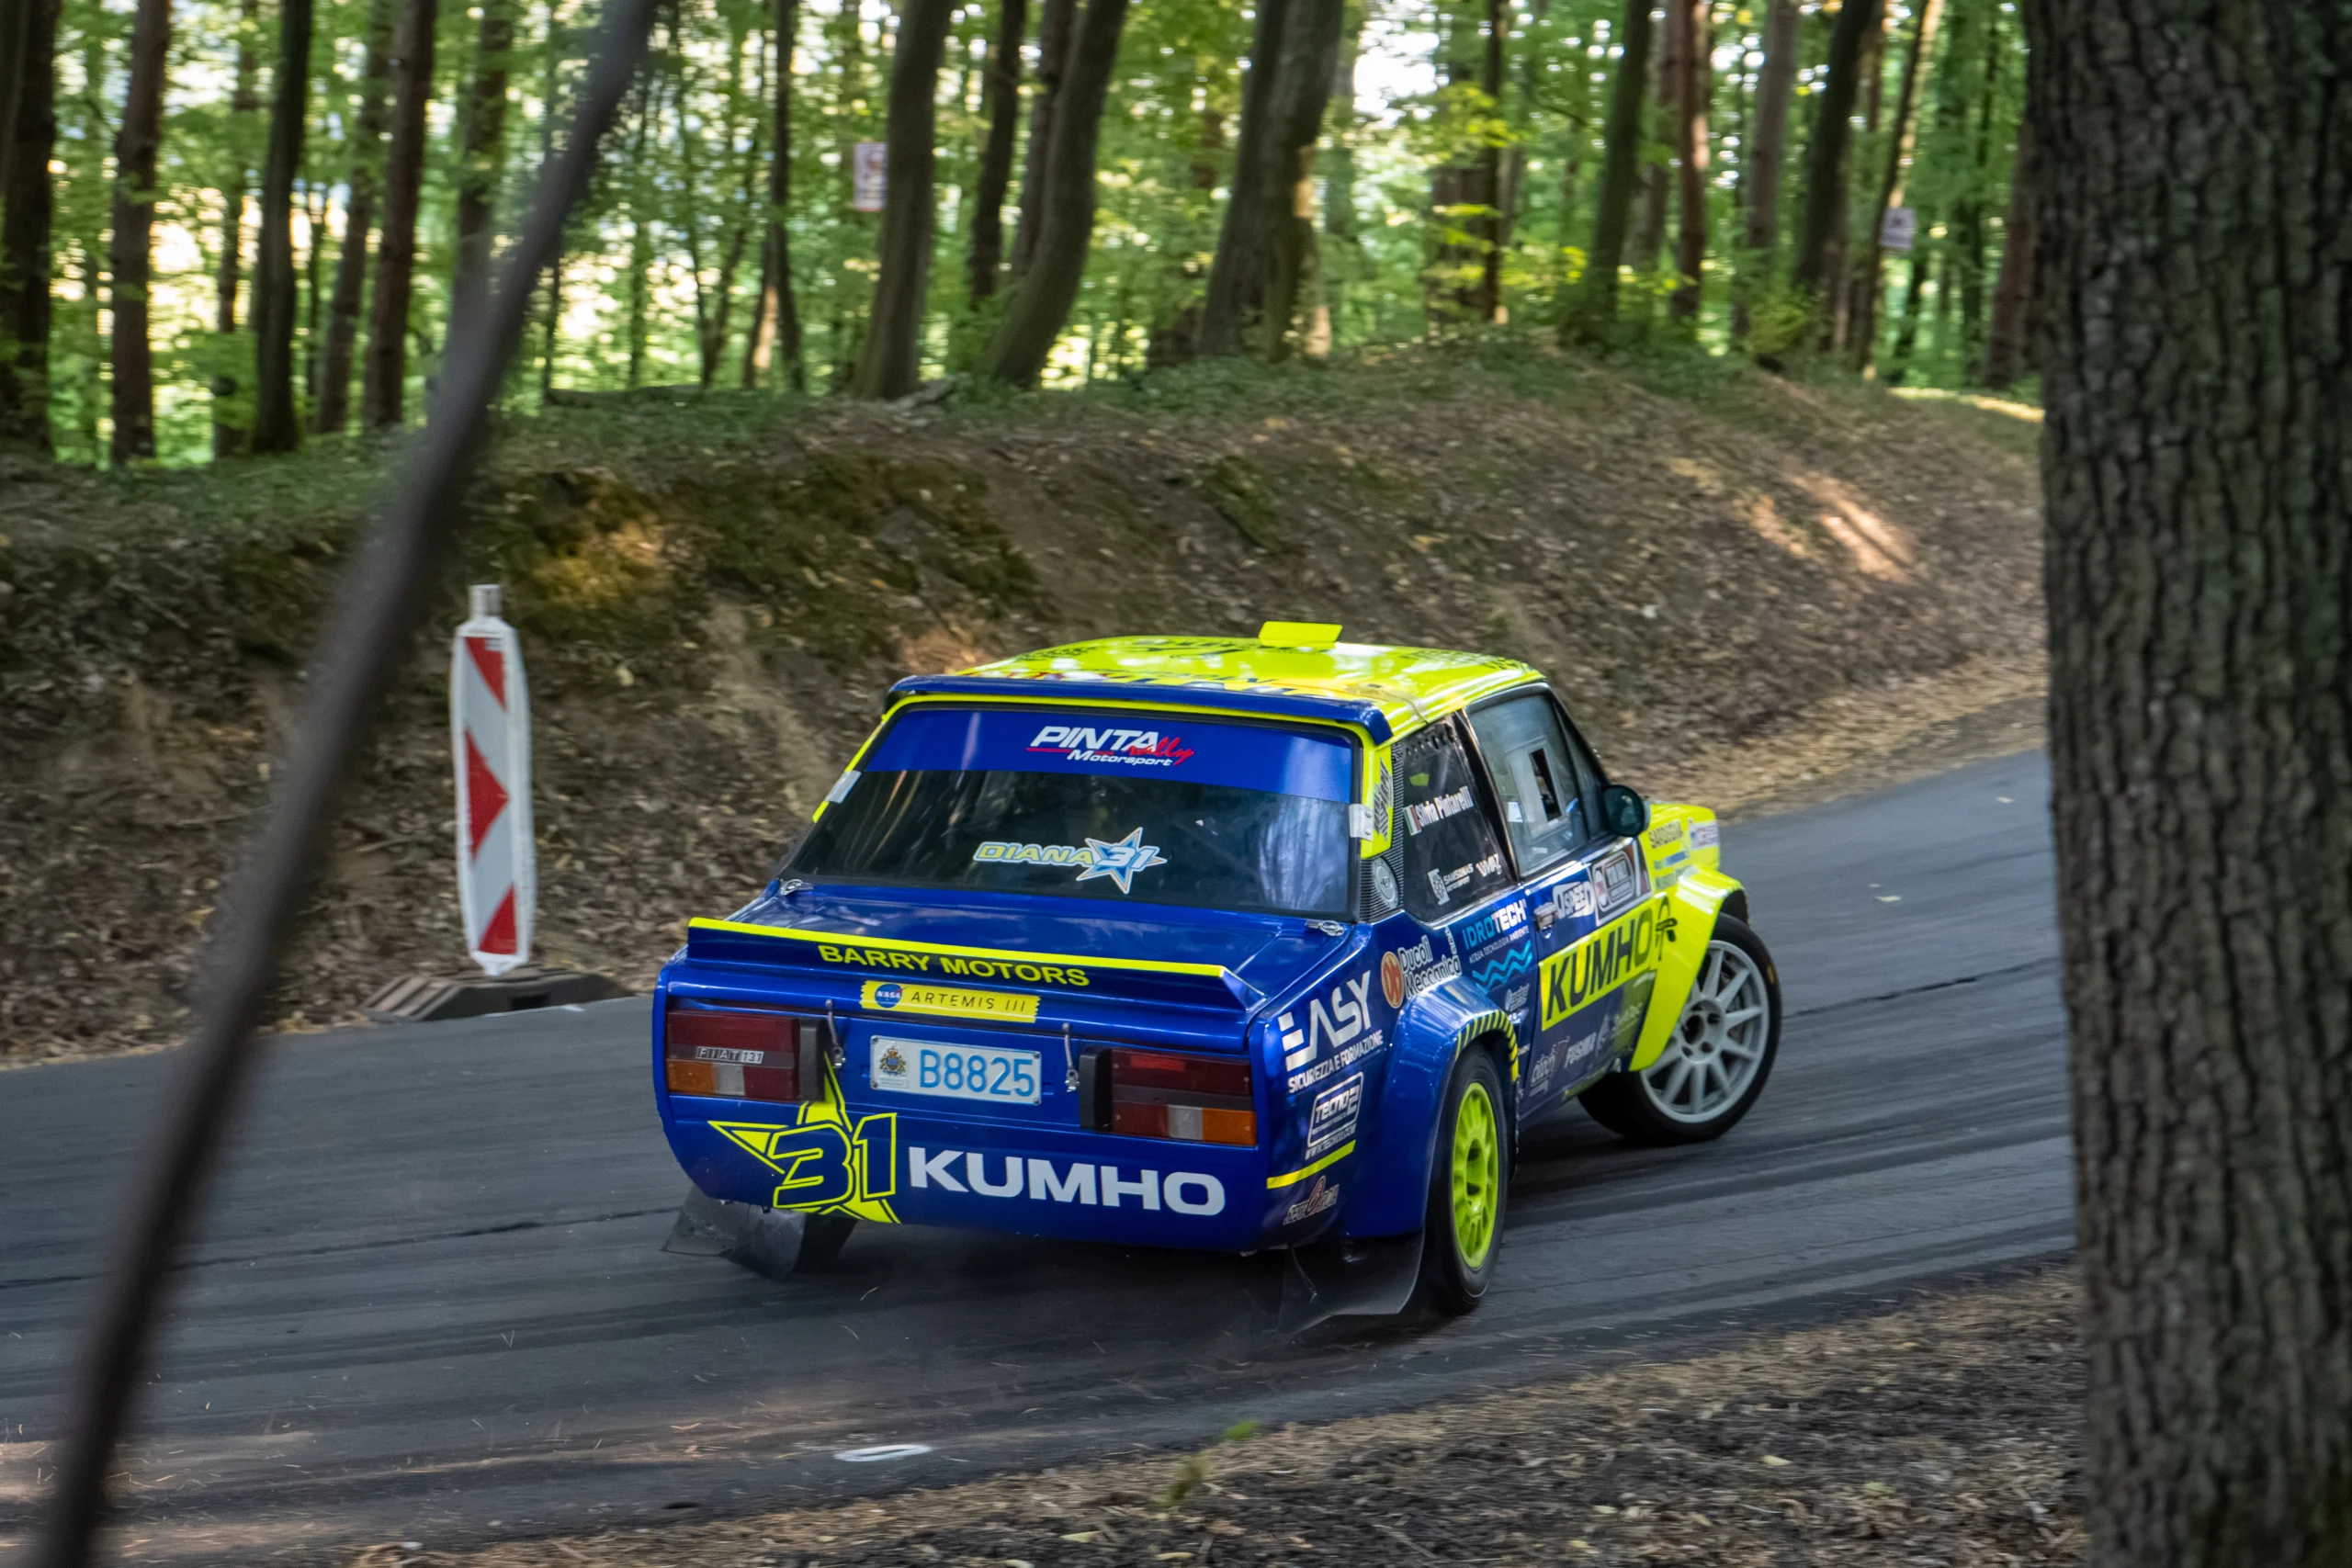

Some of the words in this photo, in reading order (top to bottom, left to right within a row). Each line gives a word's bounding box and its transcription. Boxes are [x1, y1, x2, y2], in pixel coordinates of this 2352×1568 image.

[1030, 726, 1159, 751] PINTA
[1067, 750, 1173, 766] Motorsport
[976, 843, 1094, 866] DIANA
[1096, 845, 1156, 870] 31
[1462, 898, 1527, 950] IDROTECH
[818, 944, 930, 972] BARRY
[940, 957, 1091, 987] MOTORS
[1397, 934, 1433, 973] Ducoli
[1547, 908, 1653, 1021] KUMHO
[1403, 954, 1463, 1000] Meccanica
[876, 990, 901, 999] NASA
[910, 991, 995, 1010] ARTEMIS
[1005, 999, 1026, 1012] III
[1278, 970, 1372, 1072] EASY
[698, 1048, 741, 1061] FIAT
[741, 1051, 763, 1063] 131
[920, 1049, 1035, 1097] B8825
[1288, 1060, 1335, 1094] SICUREZZA
[1334, 1055, 1341, 1071] E
[1340, 1029, 1384, 1066] FORMAZIONE
[768, 1112, 898, 1209] 31
[908, 1145, 1227, 1216] KUMHO
